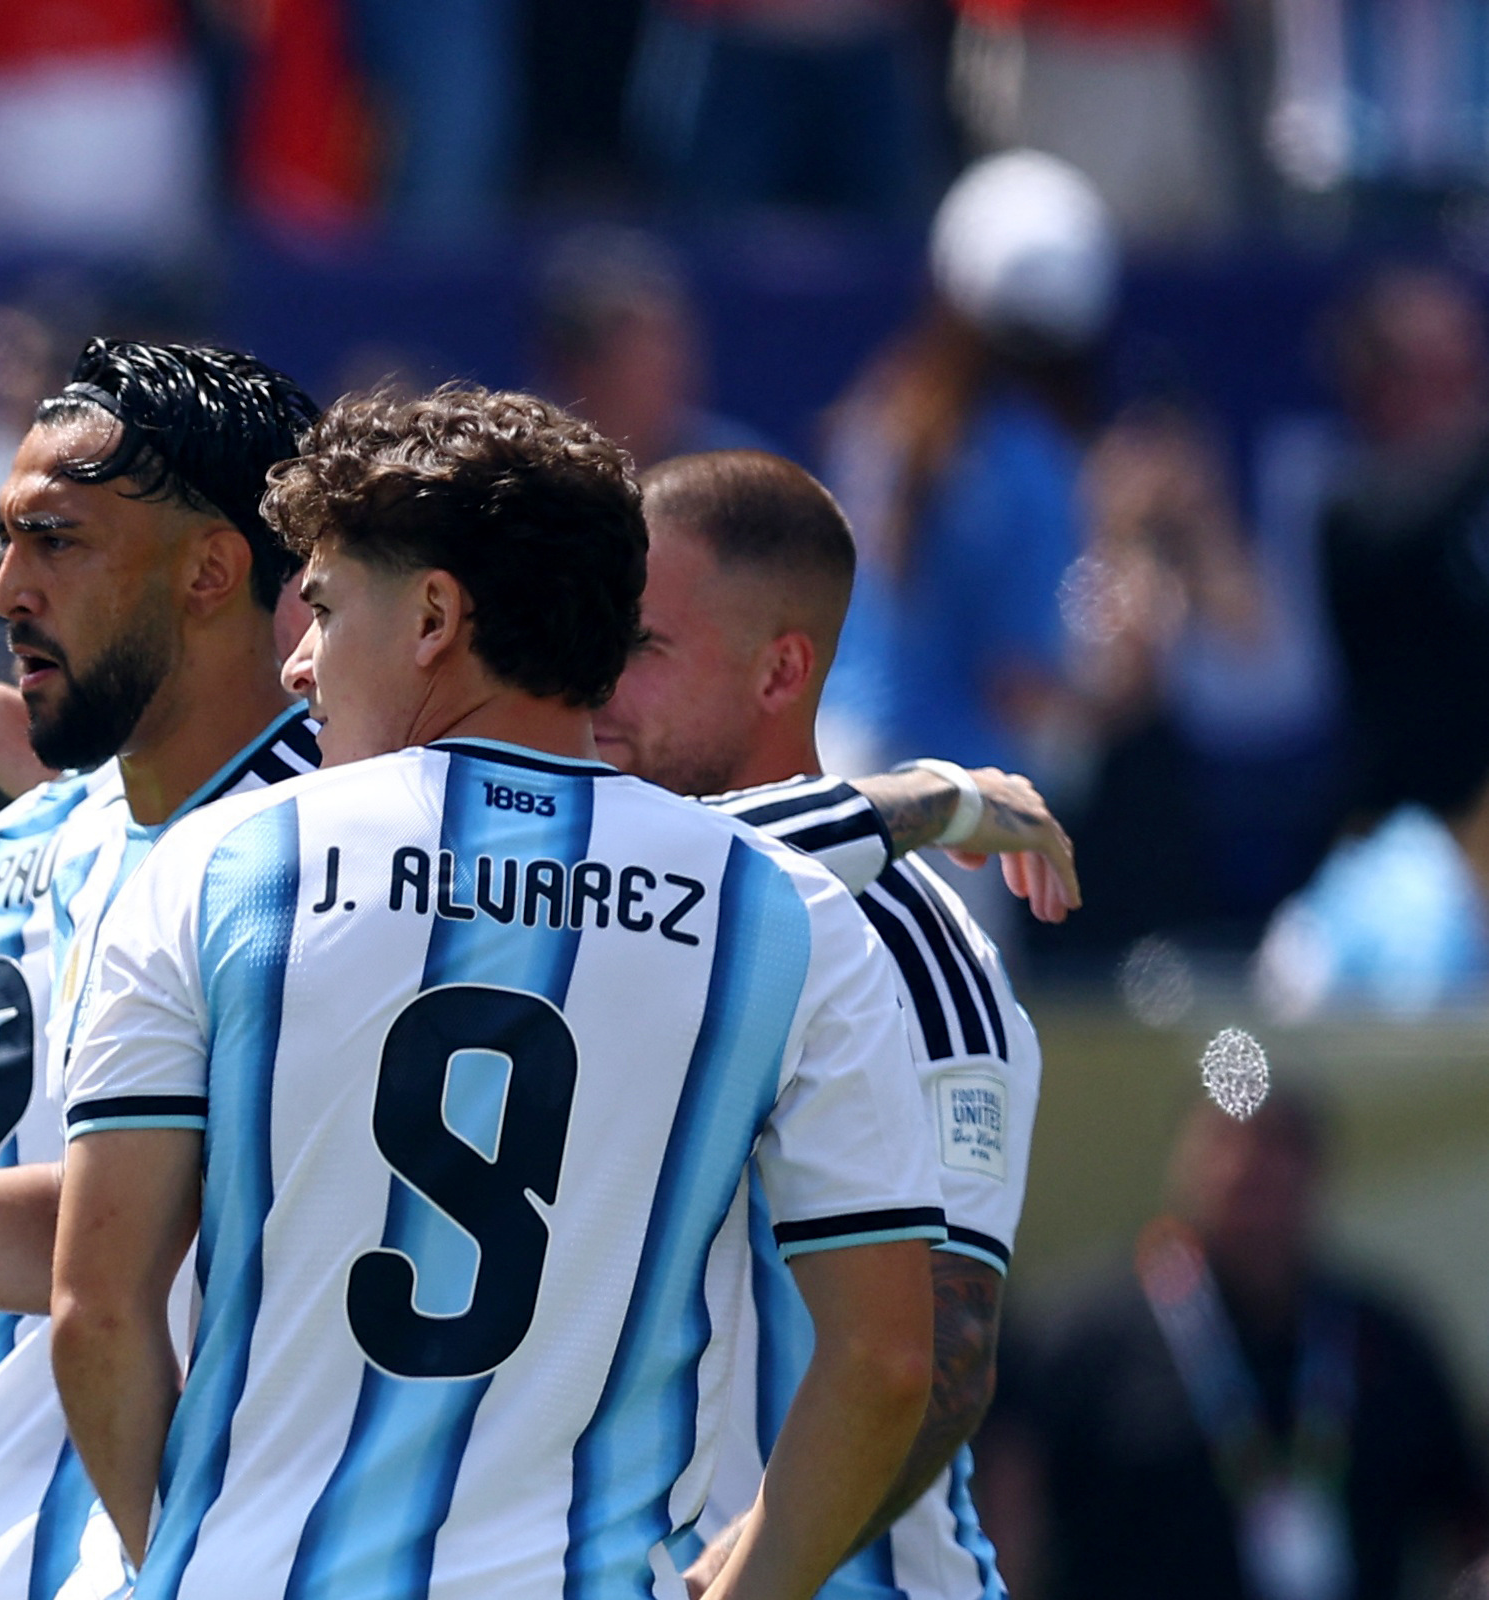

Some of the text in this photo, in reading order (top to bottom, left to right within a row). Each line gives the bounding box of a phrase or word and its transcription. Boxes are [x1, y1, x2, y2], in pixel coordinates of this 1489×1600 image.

[483, 782, 556, 817] 1893
[313, 846, 705, 946] J. ALVAREZ
[346, 983, 580, 1380] 9
